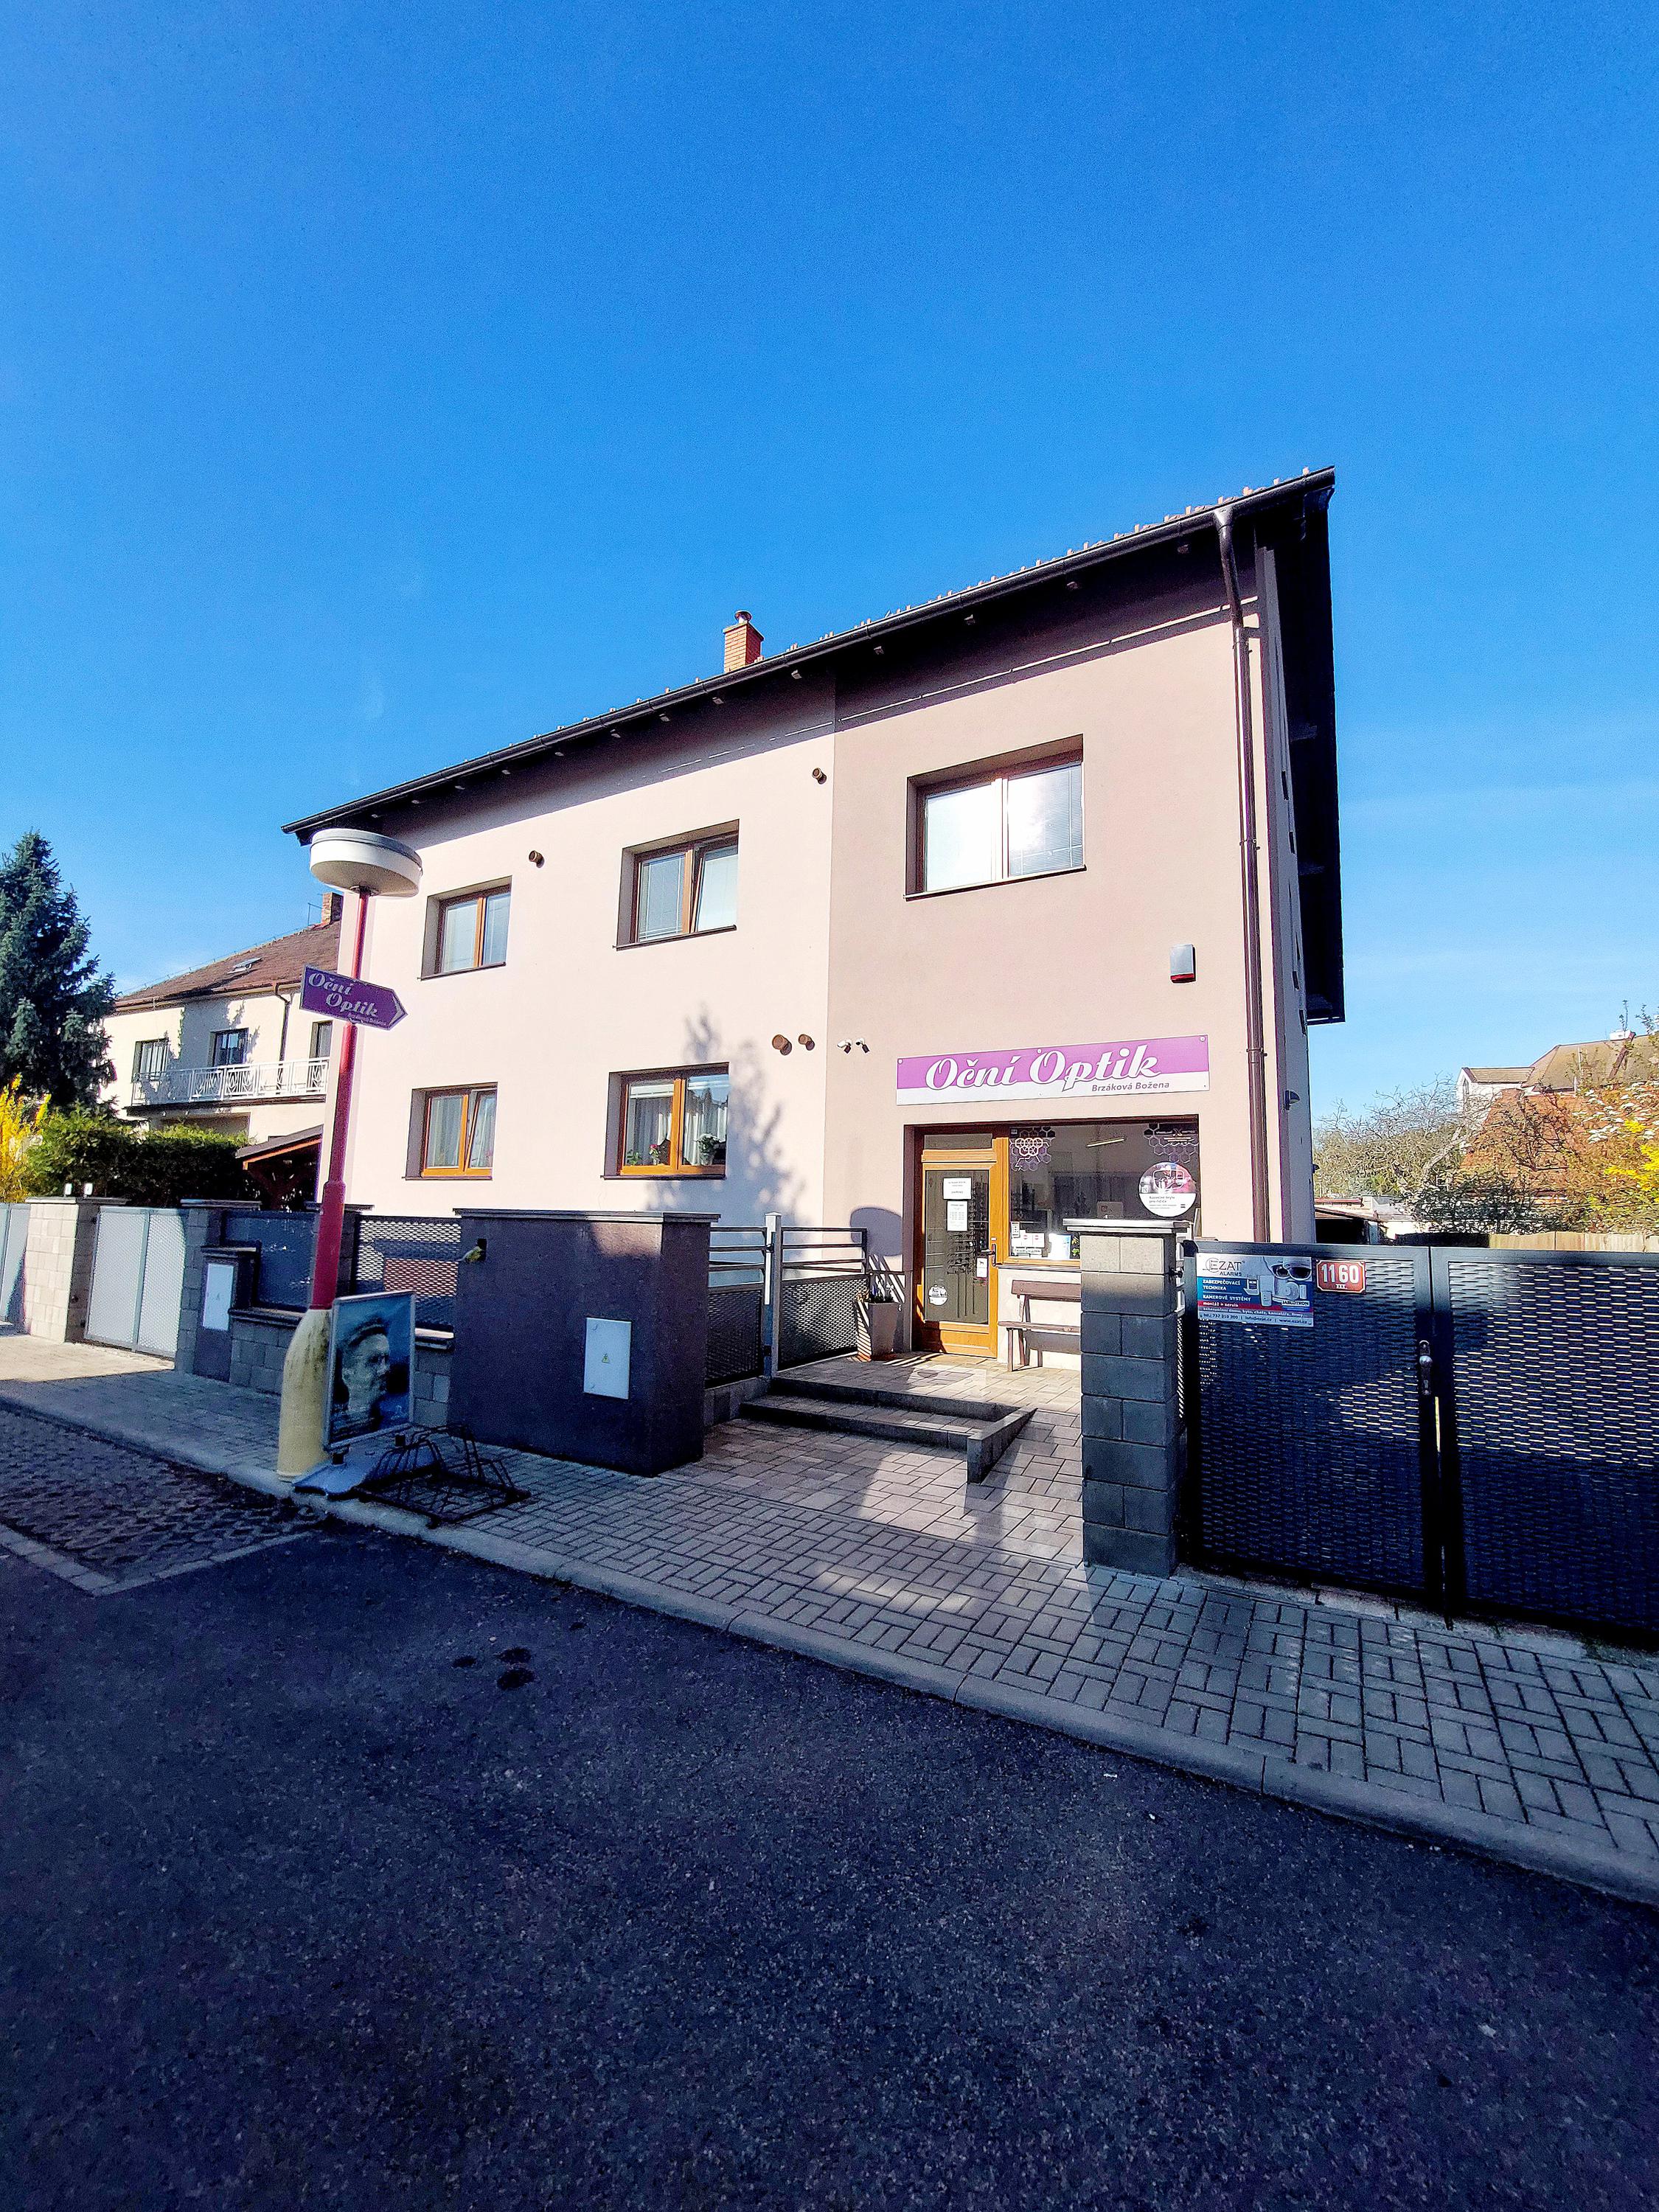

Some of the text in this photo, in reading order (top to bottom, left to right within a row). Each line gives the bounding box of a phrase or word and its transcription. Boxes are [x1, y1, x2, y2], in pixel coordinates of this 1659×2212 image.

[309, 973, 353, 995] Oční
[326, 992, 378, 1017] Optik
[925, 1044, 1161, 1091] Oční Optik
[1092, 1082, 1169, 1092] Brzáková Božena
[1208, 1259, 1242, 1271] EZAT
[1321, 1264, 1360, 1284] 1160
